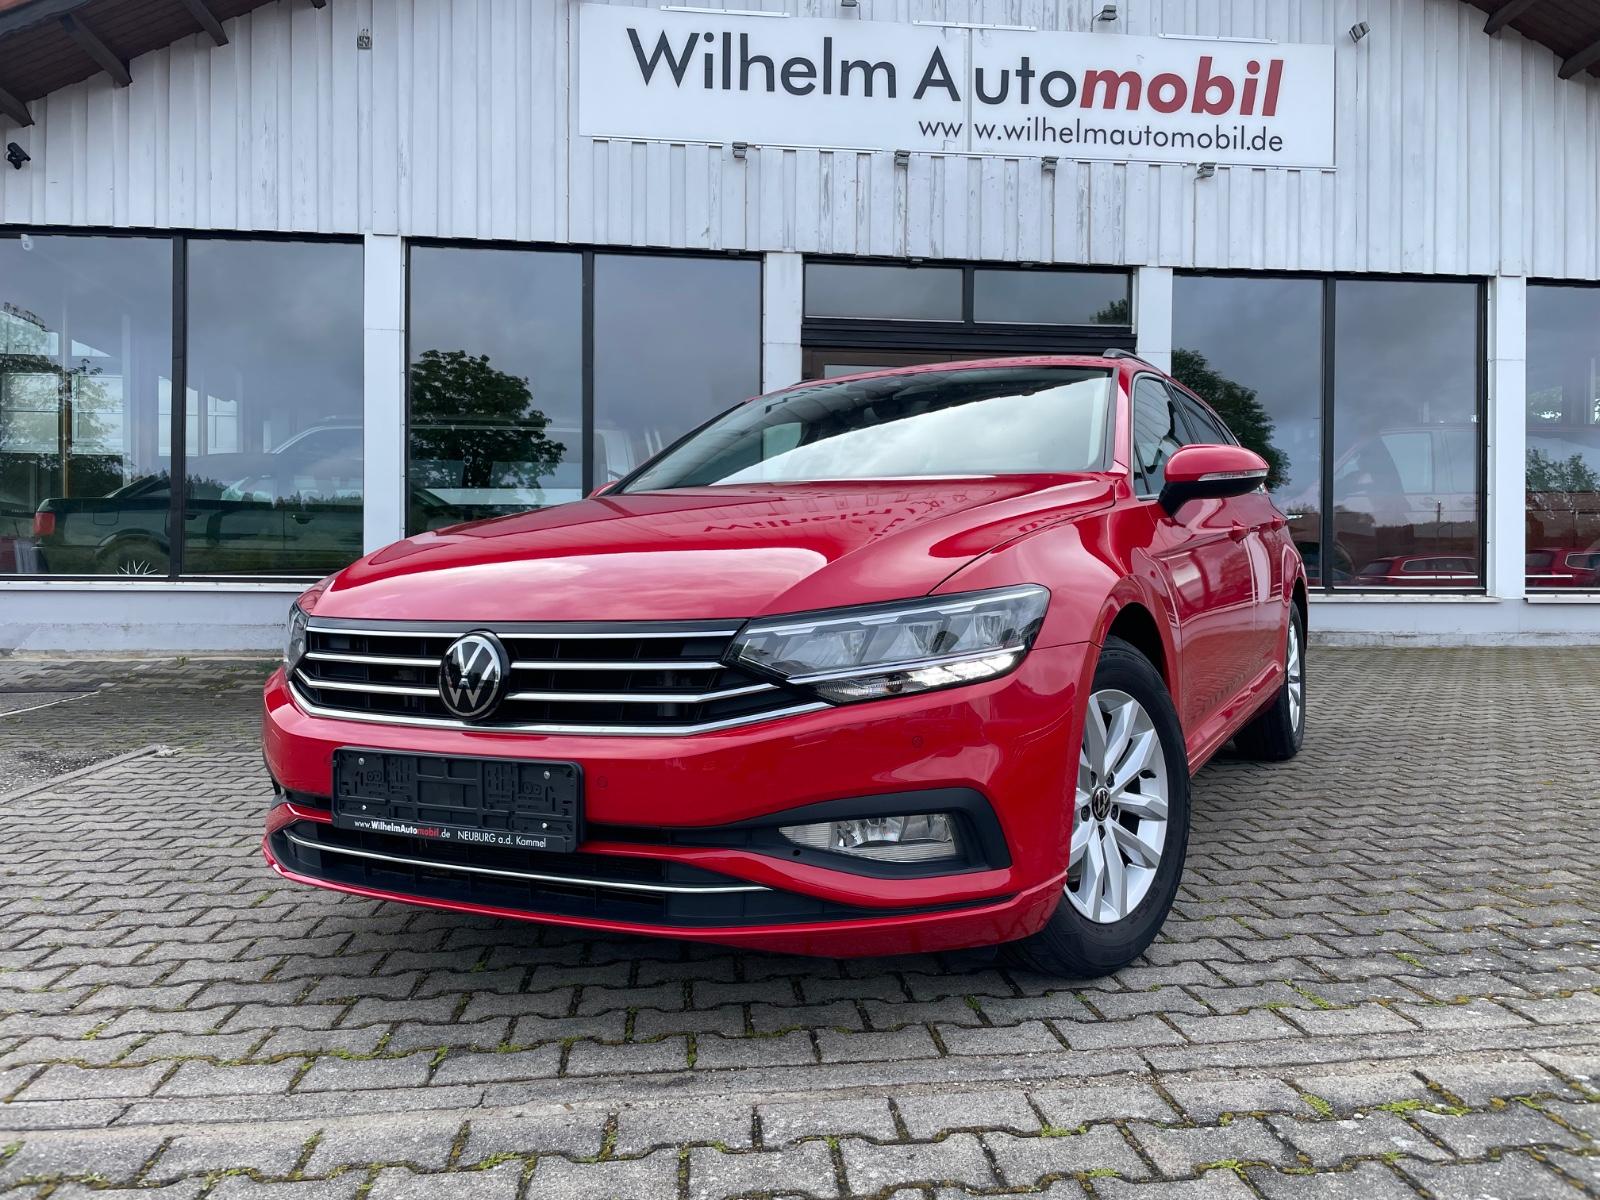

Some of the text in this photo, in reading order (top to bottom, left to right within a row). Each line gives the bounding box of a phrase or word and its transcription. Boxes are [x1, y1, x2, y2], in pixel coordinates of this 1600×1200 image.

[627, 28, 1284, 116] Wilhelm Automobil
[919, 116, 1283, 152] www.wilhelmautomobil.de
[457, 830, 496, 843] NEUBURG
[498, 834, 514, 845] a.d.
[516, 835, 547, 848] Kammel
